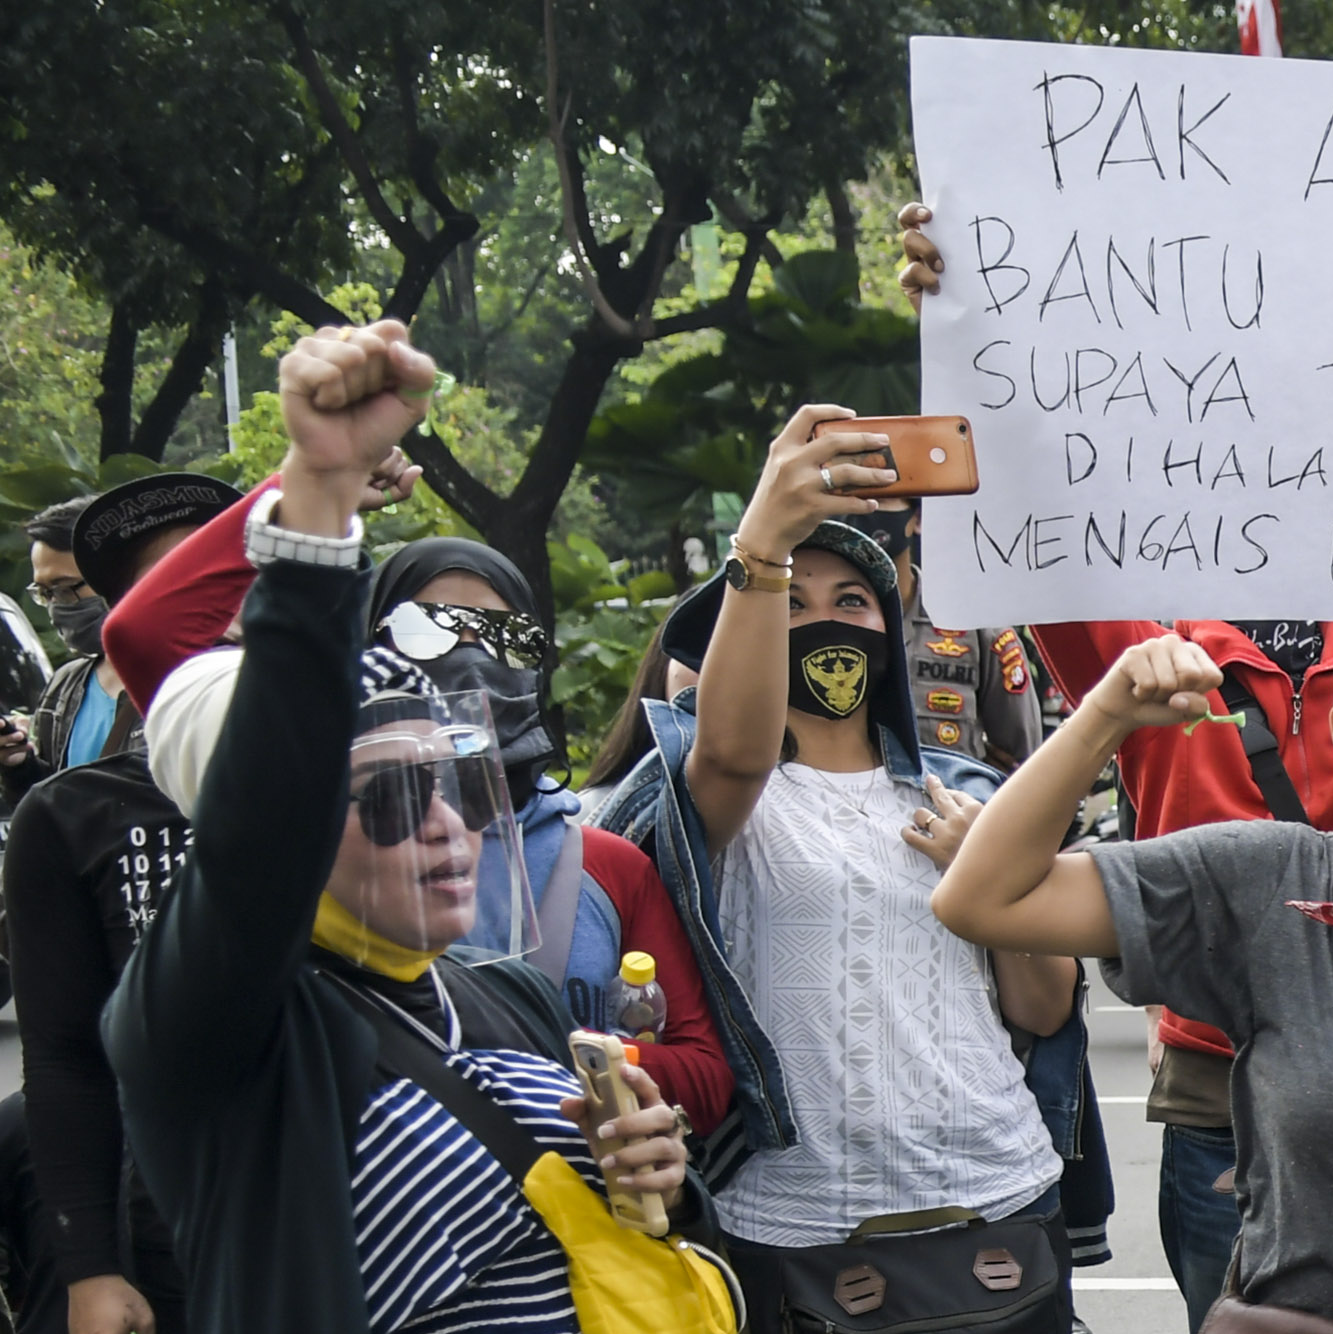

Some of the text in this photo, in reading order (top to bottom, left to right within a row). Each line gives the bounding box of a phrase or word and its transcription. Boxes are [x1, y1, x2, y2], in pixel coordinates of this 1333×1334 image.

[1033, 70, 1232, 194] PAK
[968, 214, 1264, 331] BANTU
[973, 339, 1256, 424] SUPAYA
[973, 508, 1281, 577] MENGAIS
[917, 660, 976, 685] POLRI
